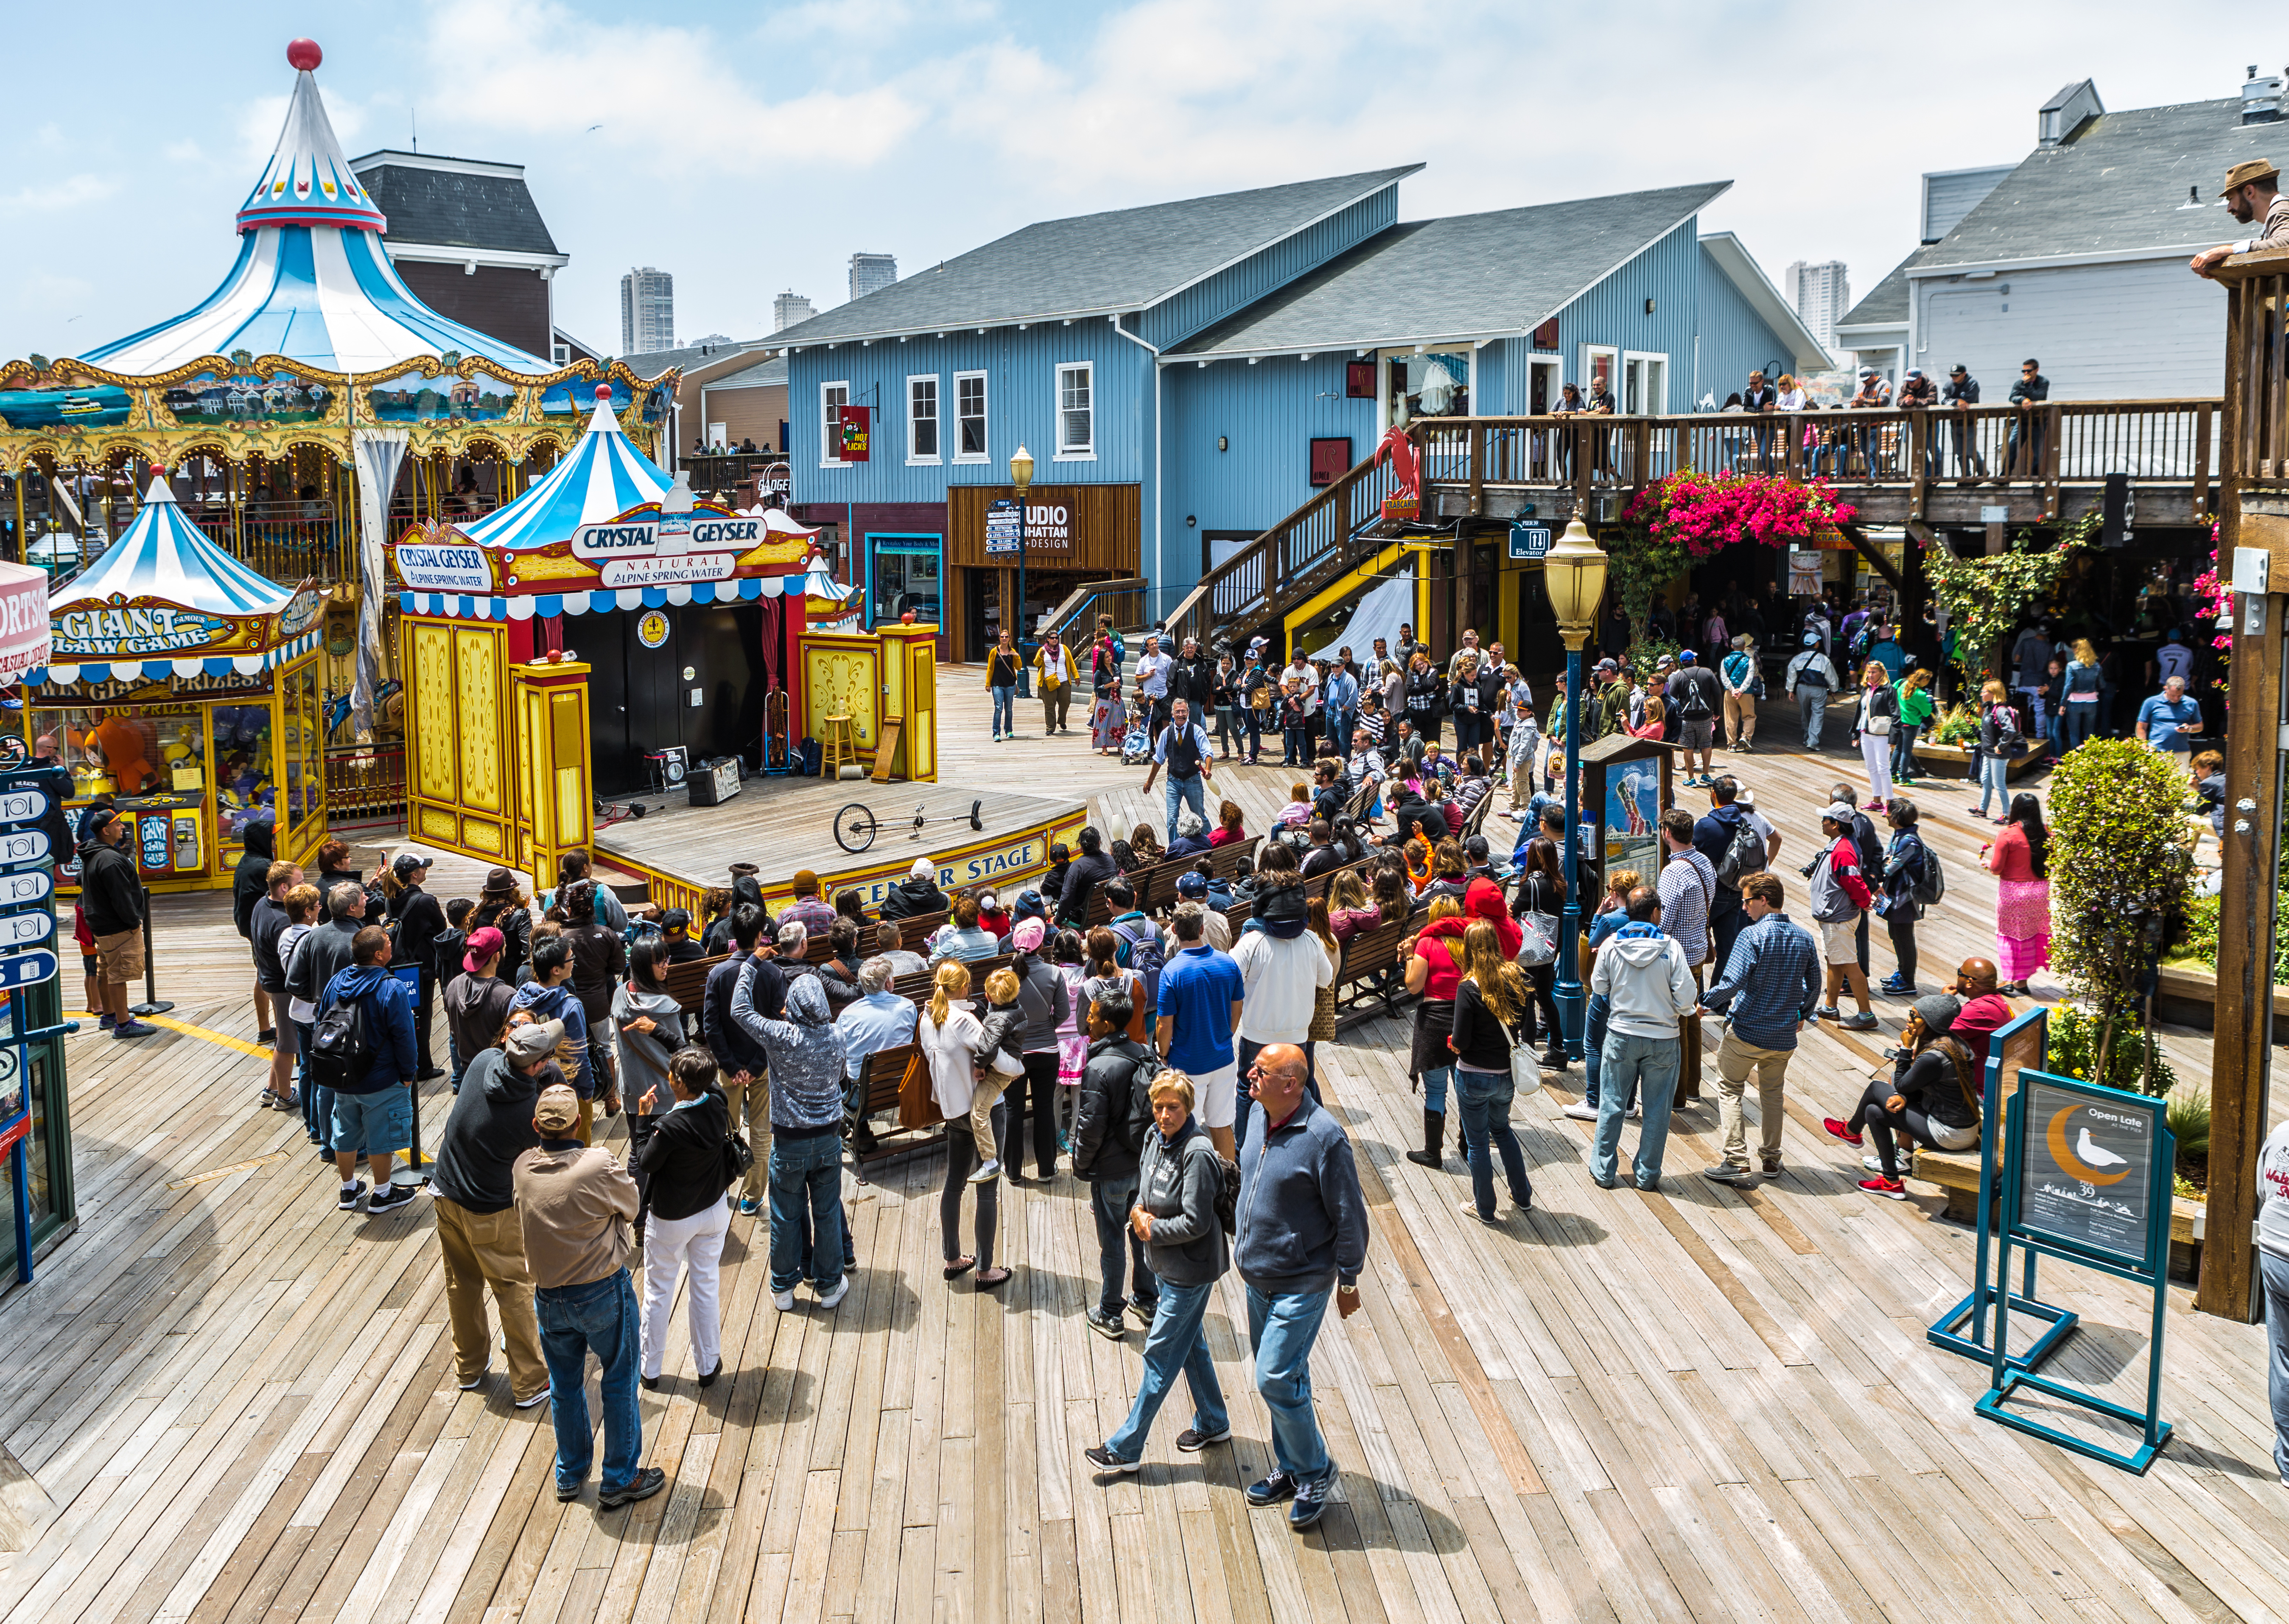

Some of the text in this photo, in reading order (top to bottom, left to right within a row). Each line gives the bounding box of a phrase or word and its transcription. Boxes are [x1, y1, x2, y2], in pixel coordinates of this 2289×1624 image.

[758, 480, 791, 491] GADGE
[1385, 500, 1417, 509] CRABCAKES
[1015, 506, 1067, 525] UDIO
[584, 522, 758, 548] CRYSTAL GEYSER
[1017, 527, 1067, 538] NHATTAN
[400, 548, 483, 569] CRYSTAL GEYSER
[627, 556, 719, 571] NATURAL
[411, 570, 483, 587] ALPINE SPRING WATER
[612, 567, 723, 585] ALPINE SPRING WATER
[62, 608, 178, 640] GIANT
[174, 615, 205, 623] FAMOUS
[639, 612, 668, 626] CRYSTAL GEYSER
[53, 628, 211, 654] LAW GAME
[2168, 658, 2178, 674] 7
[39, 670, 262, 702] WIN GIAN PRIZES!
[139, 703, 202, 717] PRIZES
[1645, 766, 1655, 776] 39
[141, 821, 168, 842] GIANT
[143, 841, 166, 852] CLAW
[144, 852, 167, 864] GAME
[856, 844, 1034, 908] CENR STAGE
[2088, 1108, 2142, 1127] Open Late
[2079, 1179, 2095, 1188] PIER
[2079, 1185, 2096, 1198] 39
